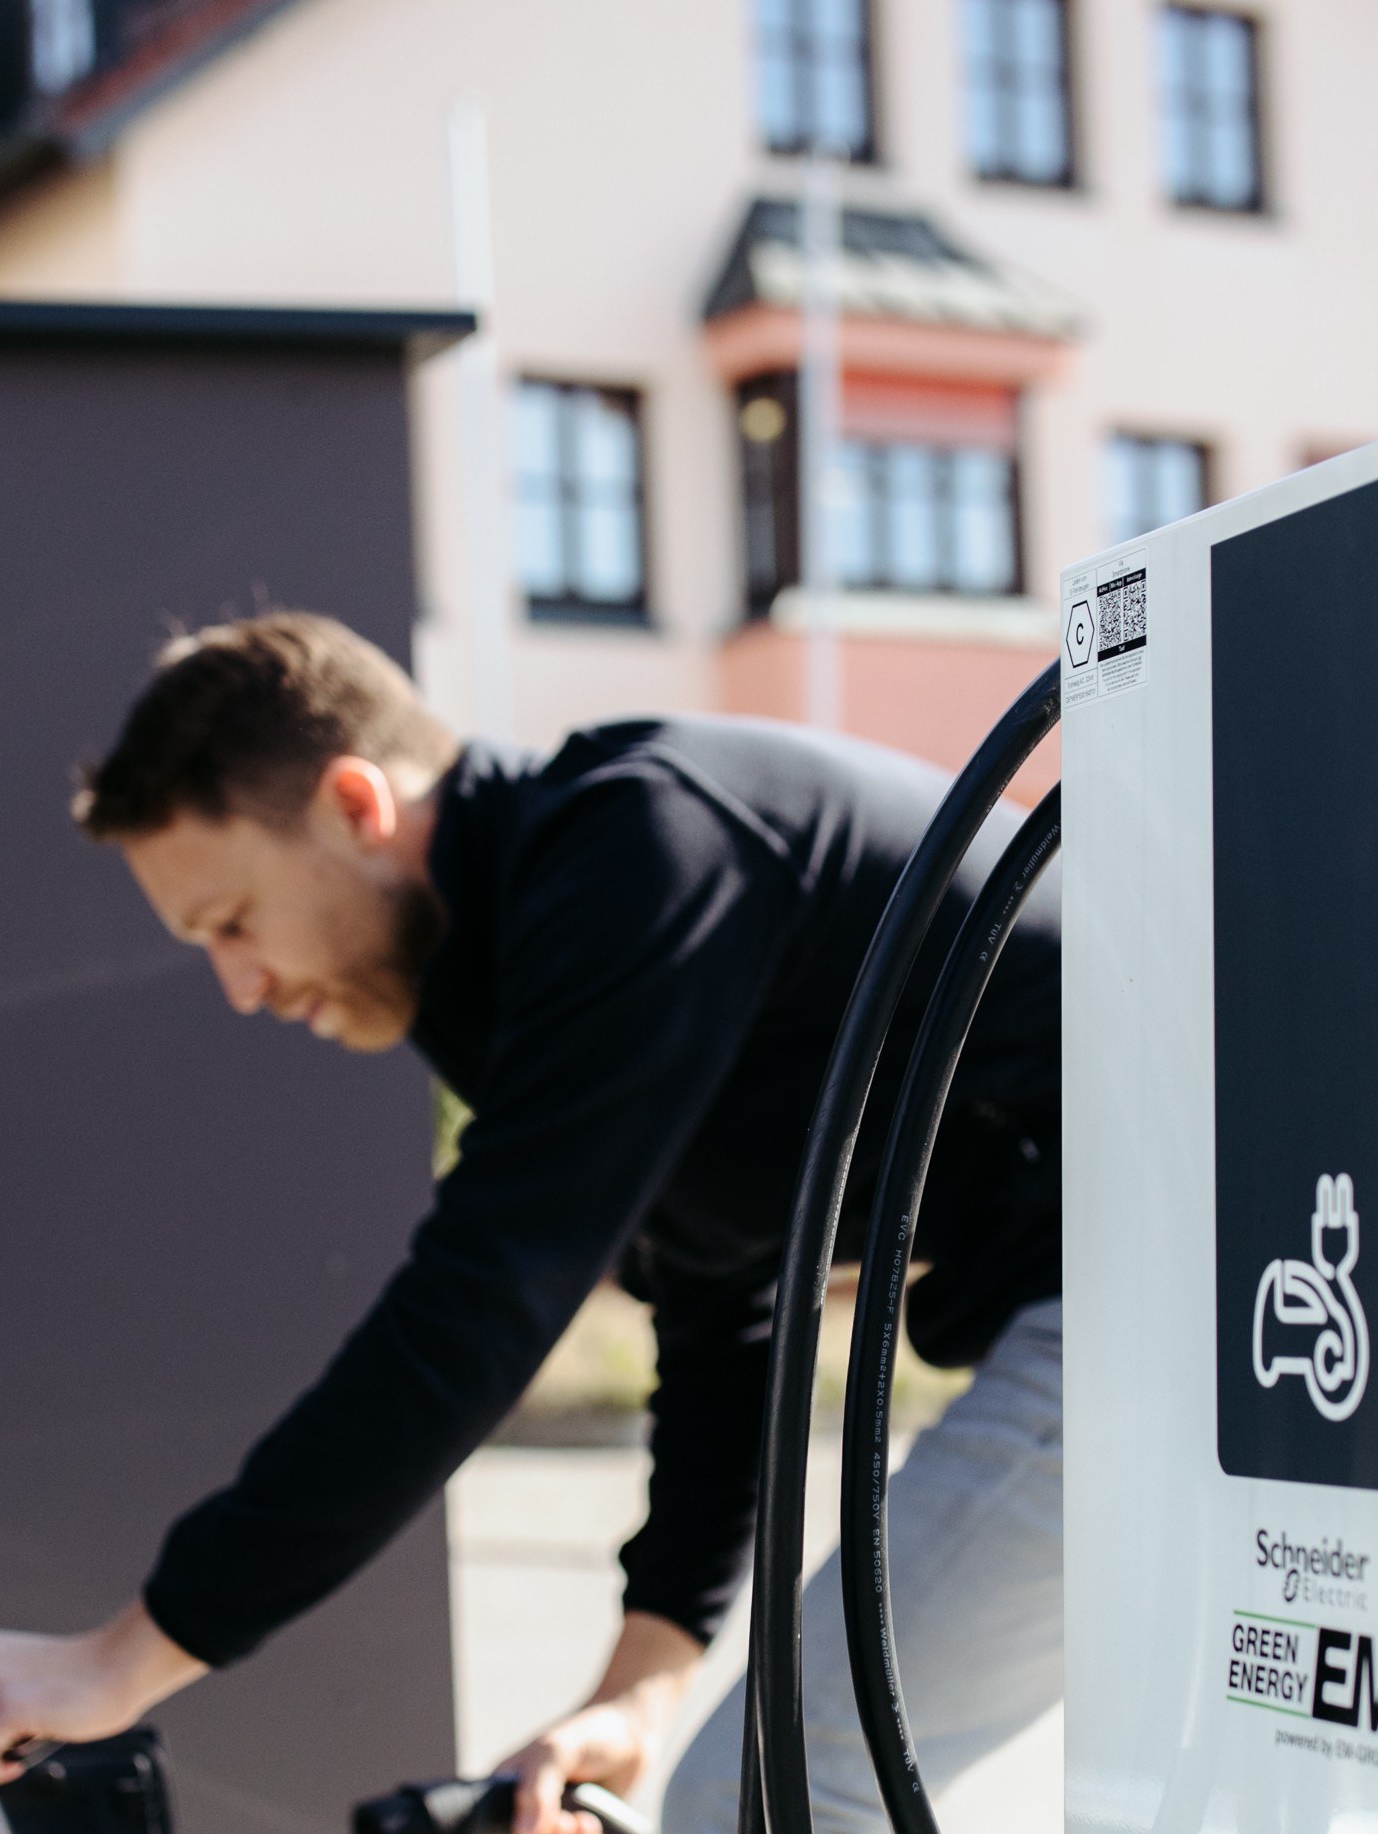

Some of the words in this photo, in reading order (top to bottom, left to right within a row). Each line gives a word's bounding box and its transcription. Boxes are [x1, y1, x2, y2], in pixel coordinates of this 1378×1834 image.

[1075, 622, 1084, 645] C
[897, 1214, 909, 1241] EVC
[872, 1452, 881, 1520] 450/750V
[872, 1529, 881, 1546] EN
[1256, 1529, 1370, 1580] Schneider
[873, 1551, 883, 1593] 50620
[1303, 1576, 1368, 1611] Electric
[1232, 1624, 1299, 1664] GREEN
[1227, 1659, 1308, 1703] ENERGY
[1275, 1729, 1318, 1752] powered
[1322, 1739, 1332, 1760] by
